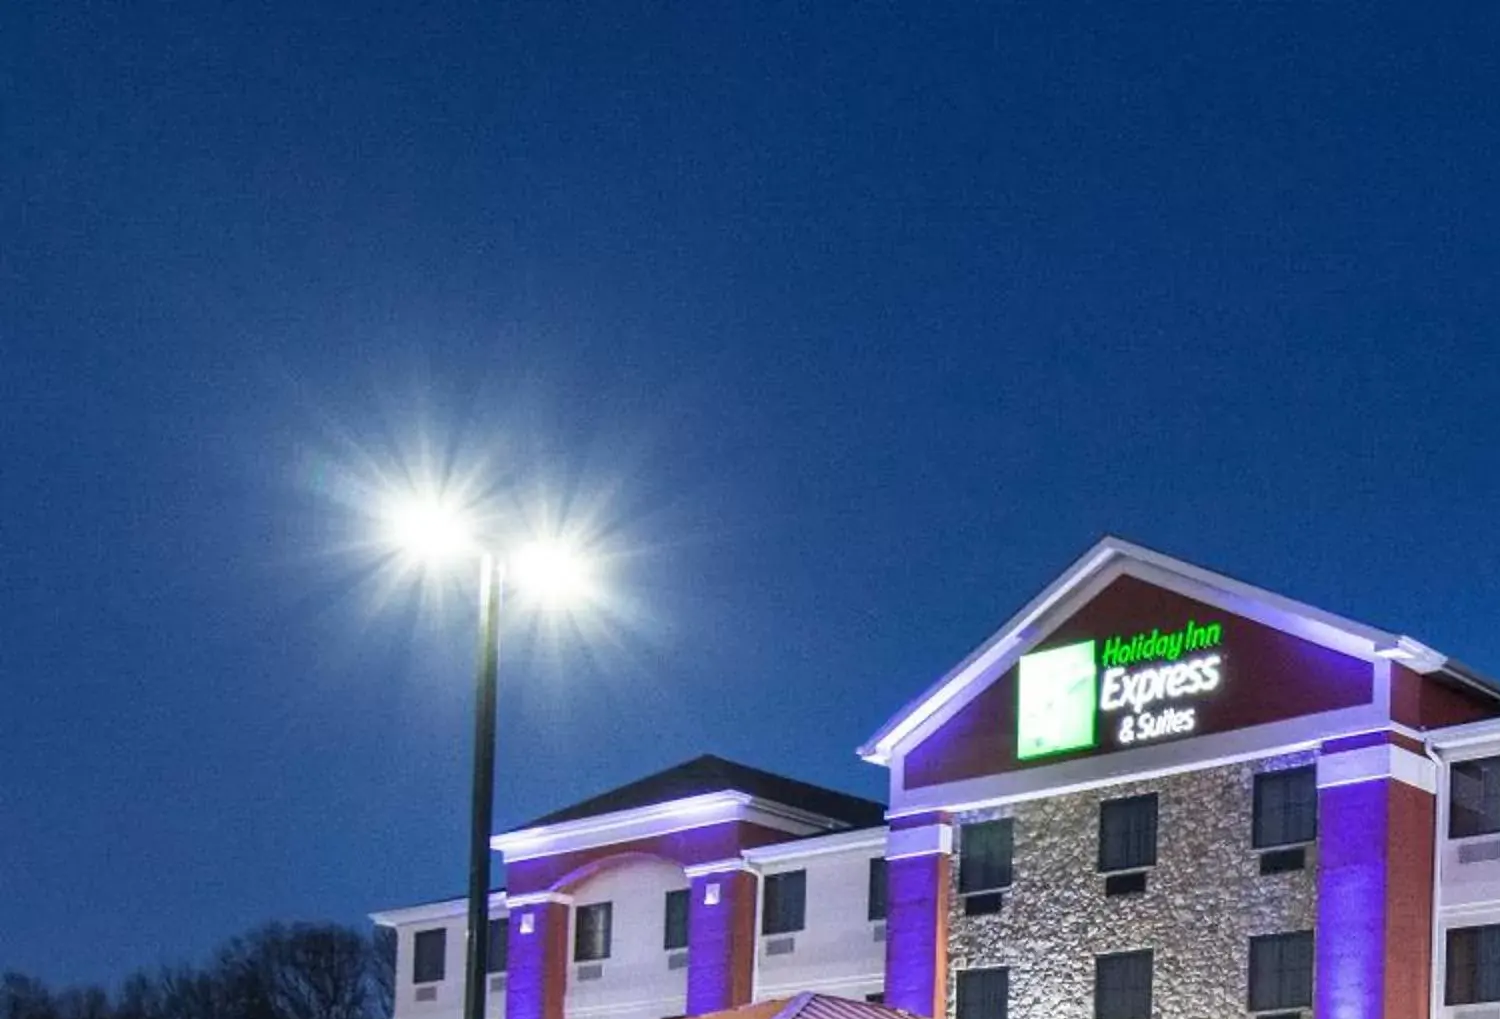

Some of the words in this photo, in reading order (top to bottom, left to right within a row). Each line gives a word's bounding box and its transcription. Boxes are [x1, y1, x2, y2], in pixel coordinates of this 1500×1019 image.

[1103, 628, 1183, 665] Holiday
[1185, 620, 1222, 650] Inn
[1100, 655, 1221, 713] Express
[1118, 715, 1135, 743] &
[1135, 707, 1195, 741] Suites
